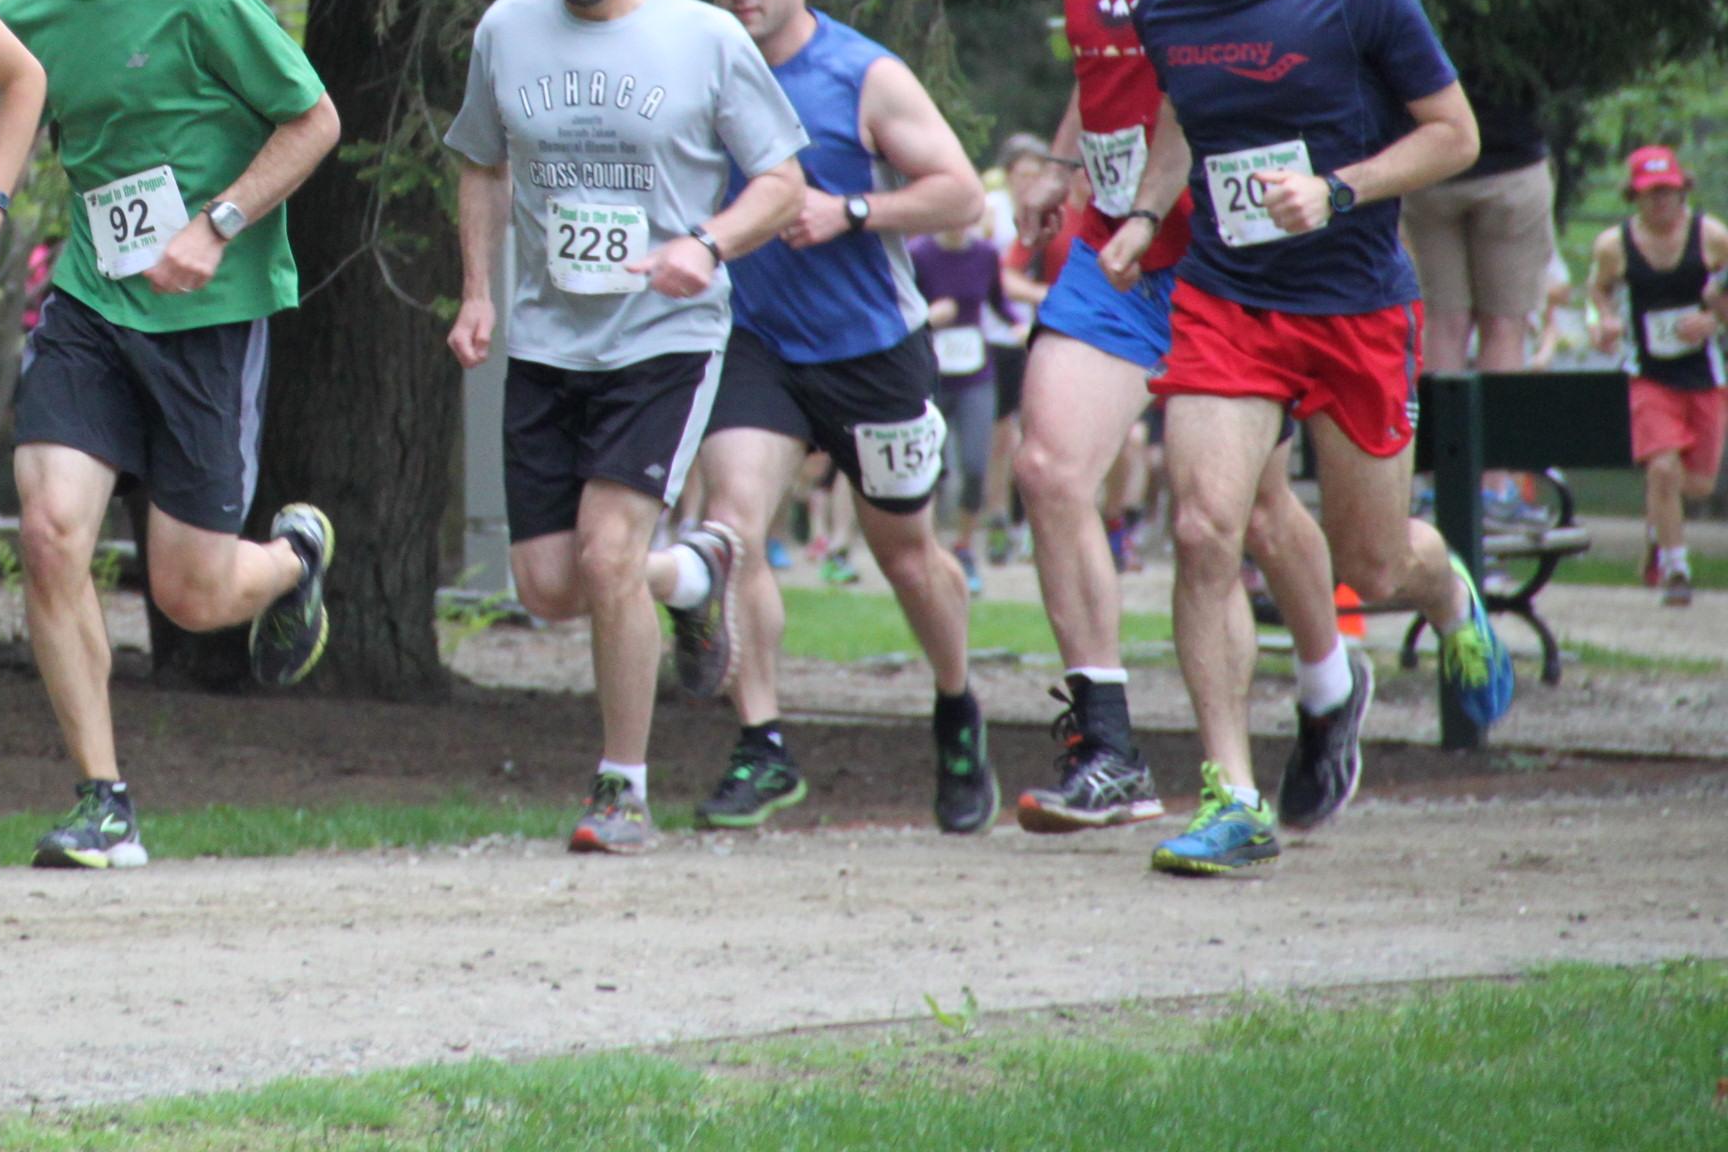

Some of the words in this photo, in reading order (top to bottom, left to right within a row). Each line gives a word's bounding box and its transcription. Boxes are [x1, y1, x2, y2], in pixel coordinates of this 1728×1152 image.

[1168, 42, 1274, 67] saucony
[519, 70, 666, 120] ITHACA
[529, 159, 578, 189] CROSS
[581, 161, 656, 191] COUNTRY
[1223, 171, 1272, 213] 20
[110, 198, 156, 243] 92
[558, 224, 628, 263] 228
